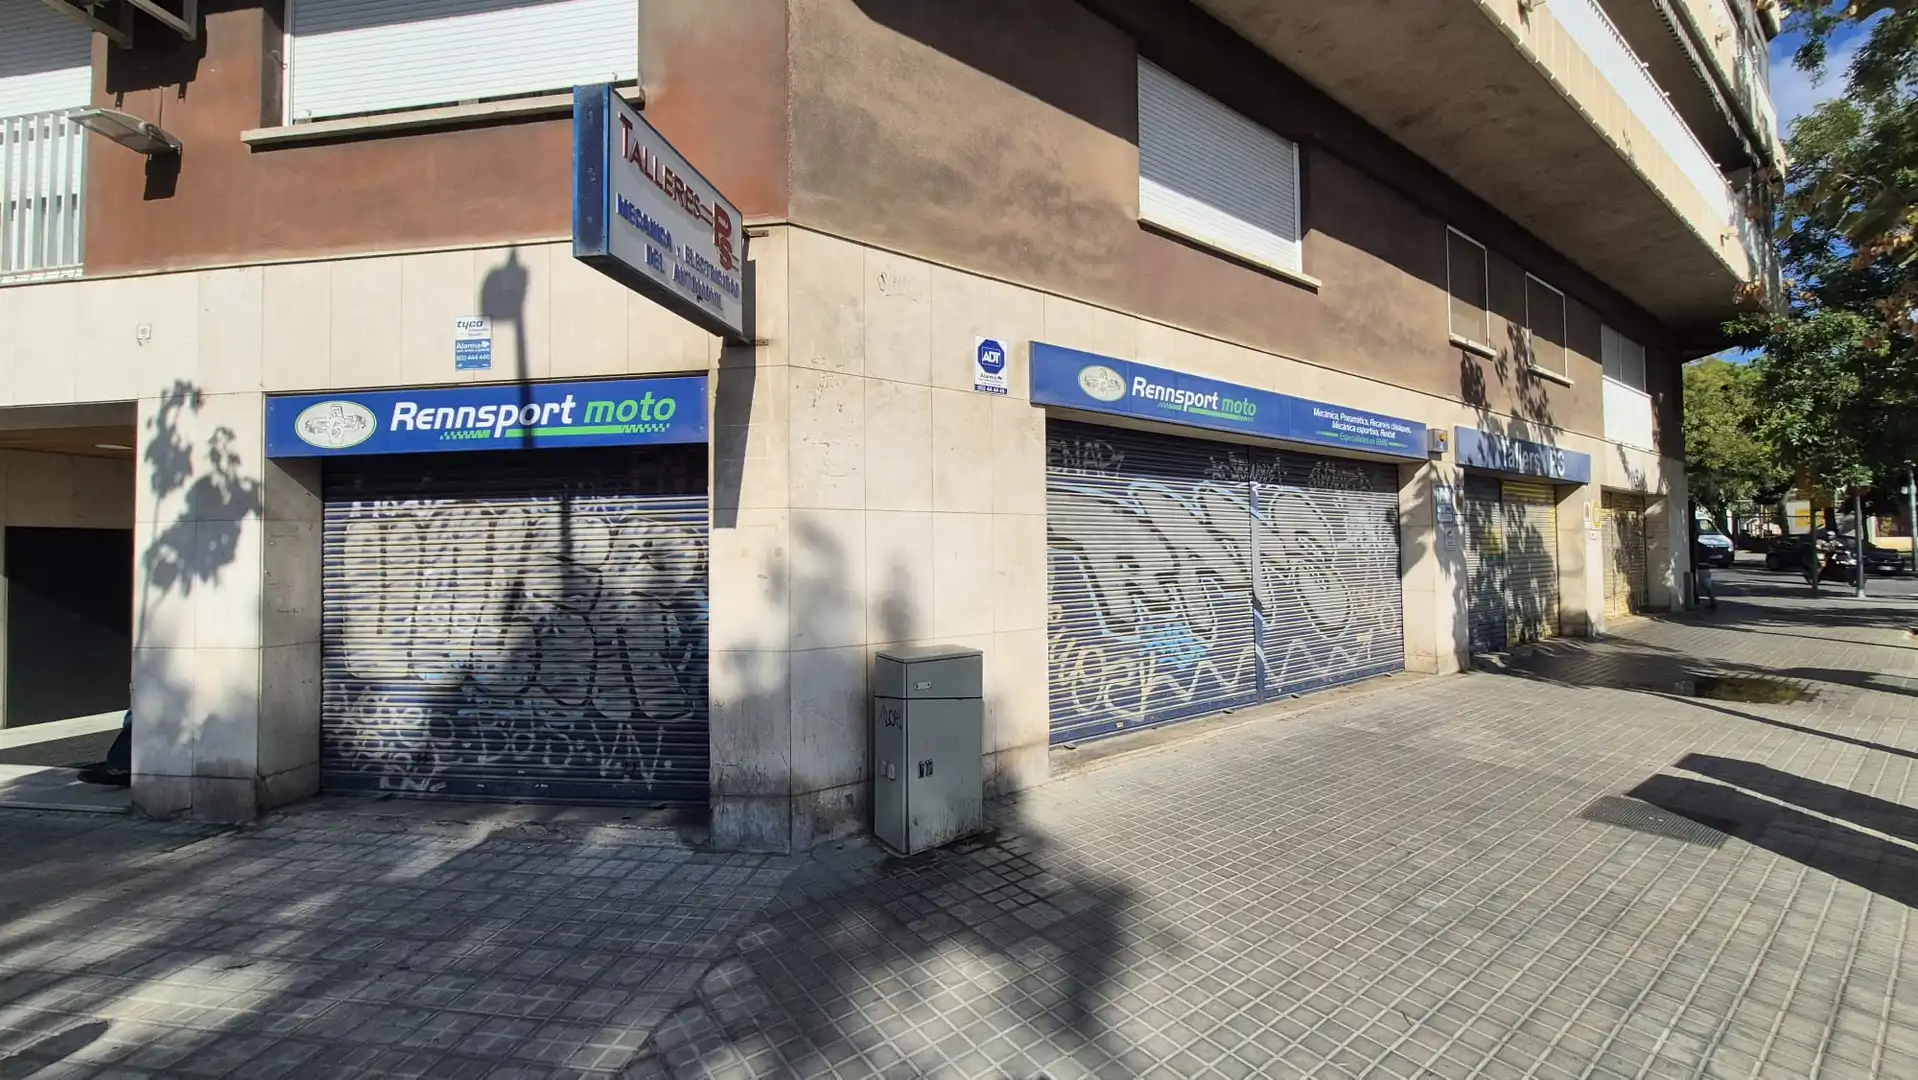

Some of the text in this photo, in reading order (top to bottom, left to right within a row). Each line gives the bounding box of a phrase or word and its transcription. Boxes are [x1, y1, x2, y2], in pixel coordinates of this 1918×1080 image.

[618, 111, 700, 221] TALLERES
[645, 243, 666, 274] DEL
[456, 320, 484, 330] tyco
[981, 350, 1001, 365] ADT
[1132, 375, 1257, 417] Rennsport moto
[390, 391, 677, 438] Rennsport moto
